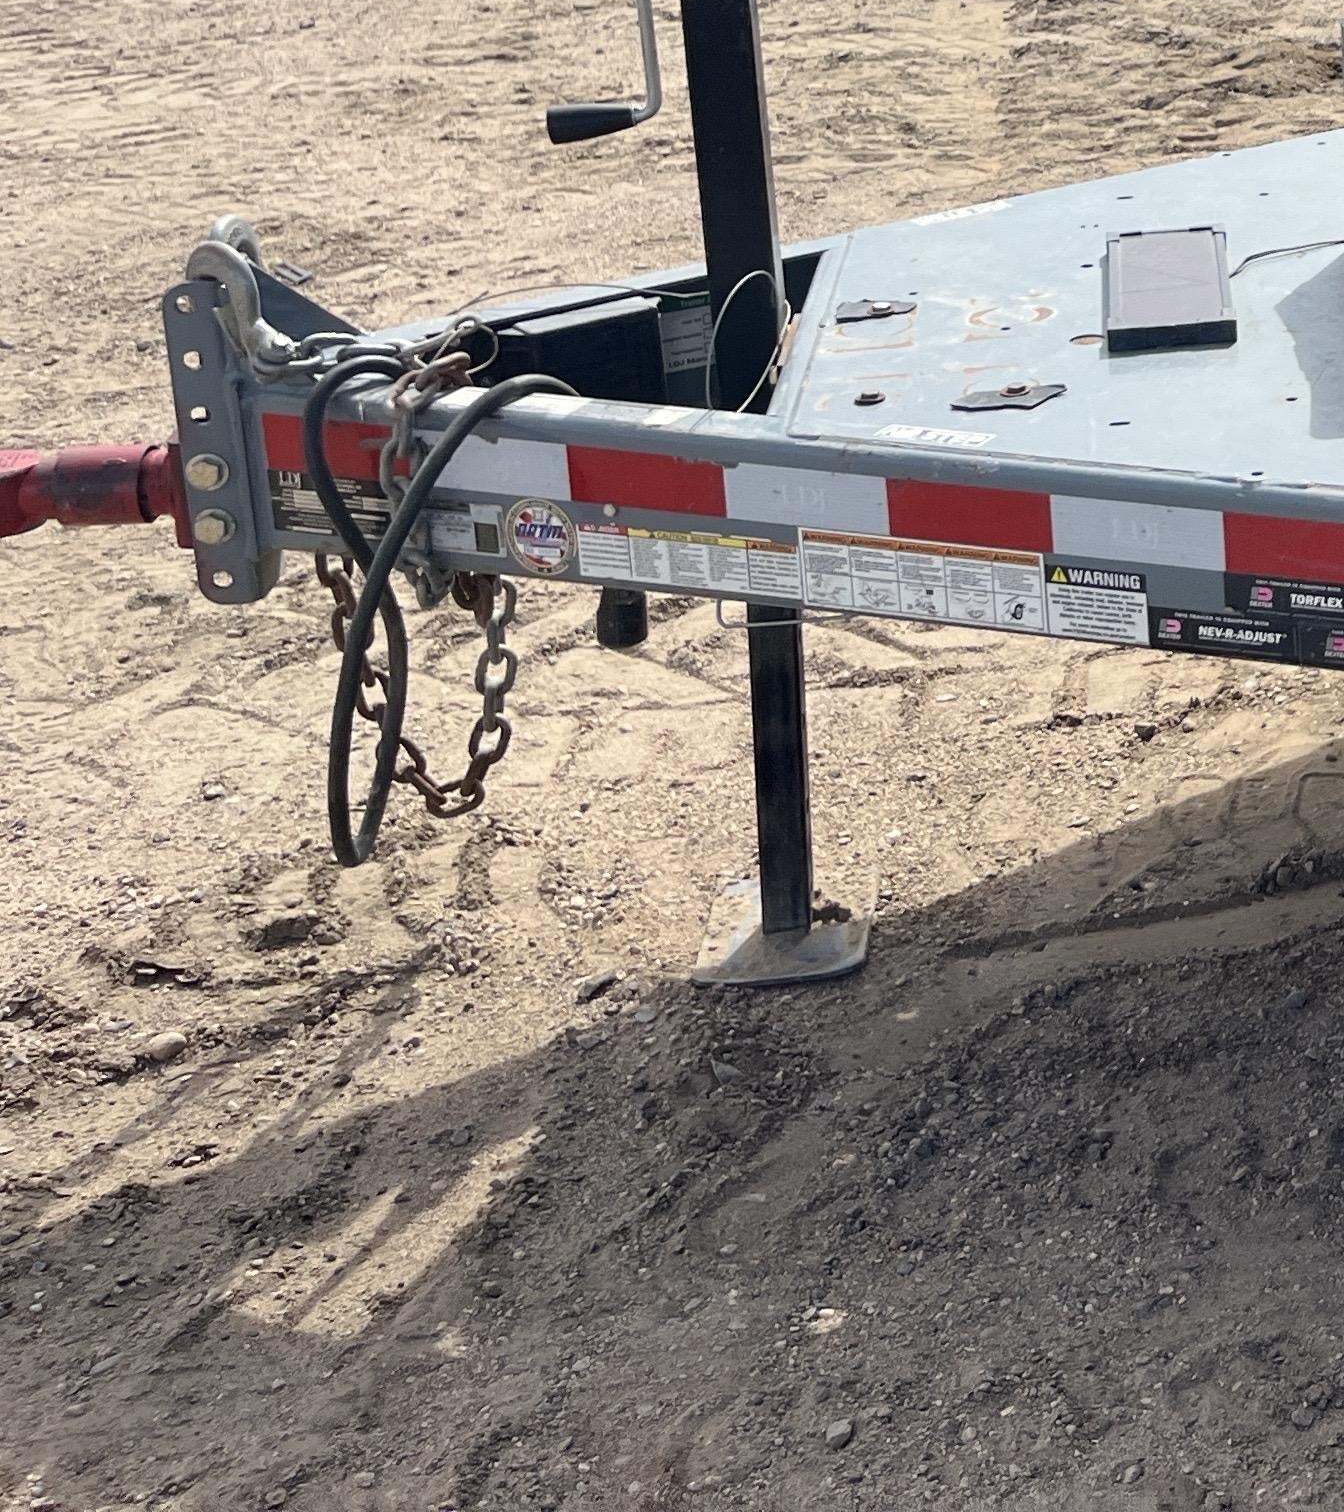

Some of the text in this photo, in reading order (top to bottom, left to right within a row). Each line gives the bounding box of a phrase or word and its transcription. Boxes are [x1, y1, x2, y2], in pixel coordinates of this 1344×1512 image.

[1068, 568, 1141, 590] WARNING
[1290, 593, 1343, 609] TORFLEX
[1198, 624, 1282, 644] NEV-R-ADJUST
